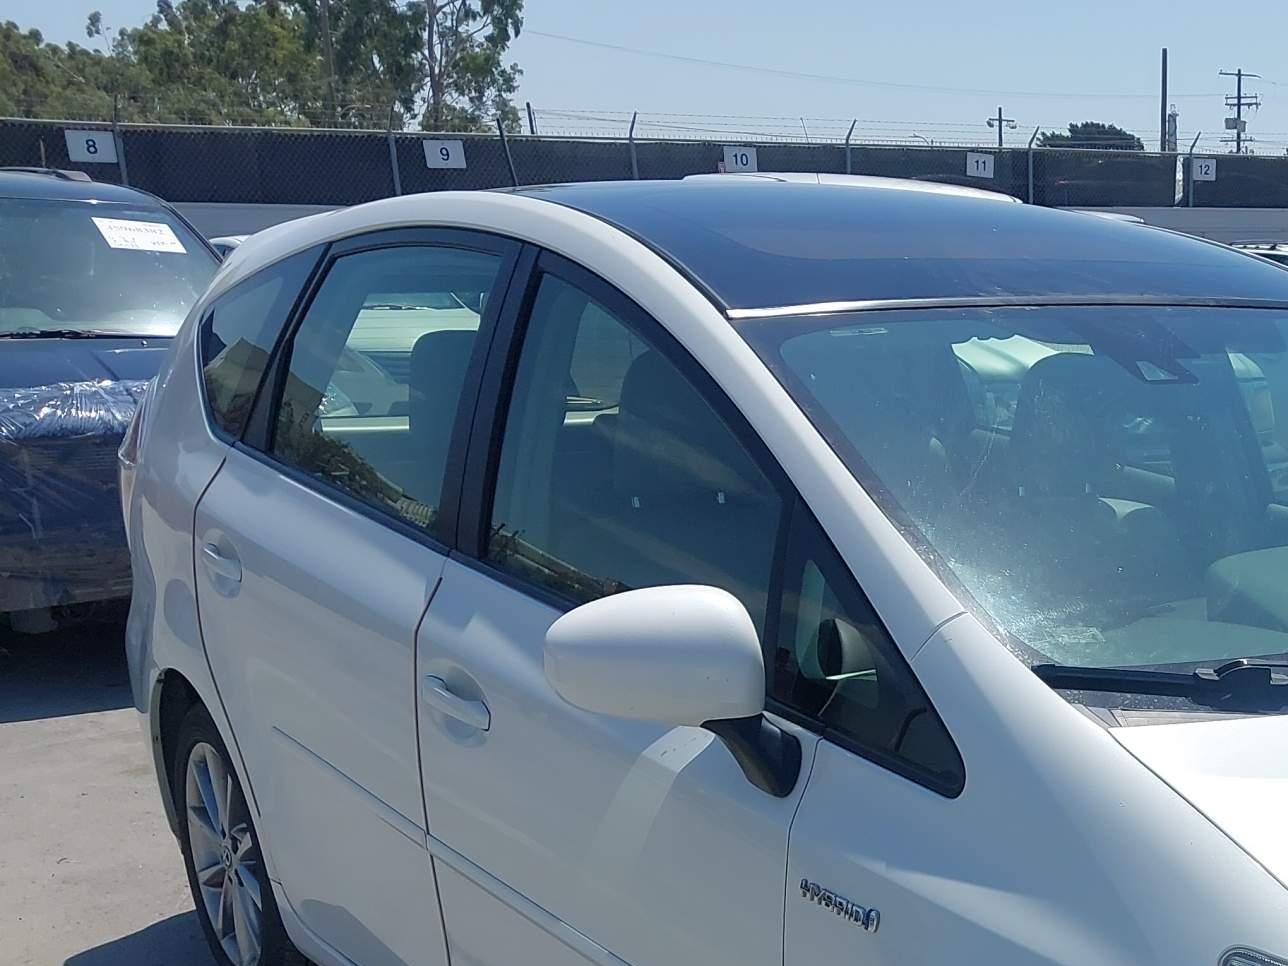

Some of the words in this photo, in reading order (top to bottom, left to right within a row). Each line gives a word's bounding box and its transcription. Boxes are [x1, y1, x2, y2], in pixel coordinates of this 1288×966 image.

[86, 139, 98, 154] 8
[440, 147, 450, 161] 9
[732, 153, 749, 166] 10
[974, 160, 986, 171] 11
[1198, 164, 1210, 176] 12
